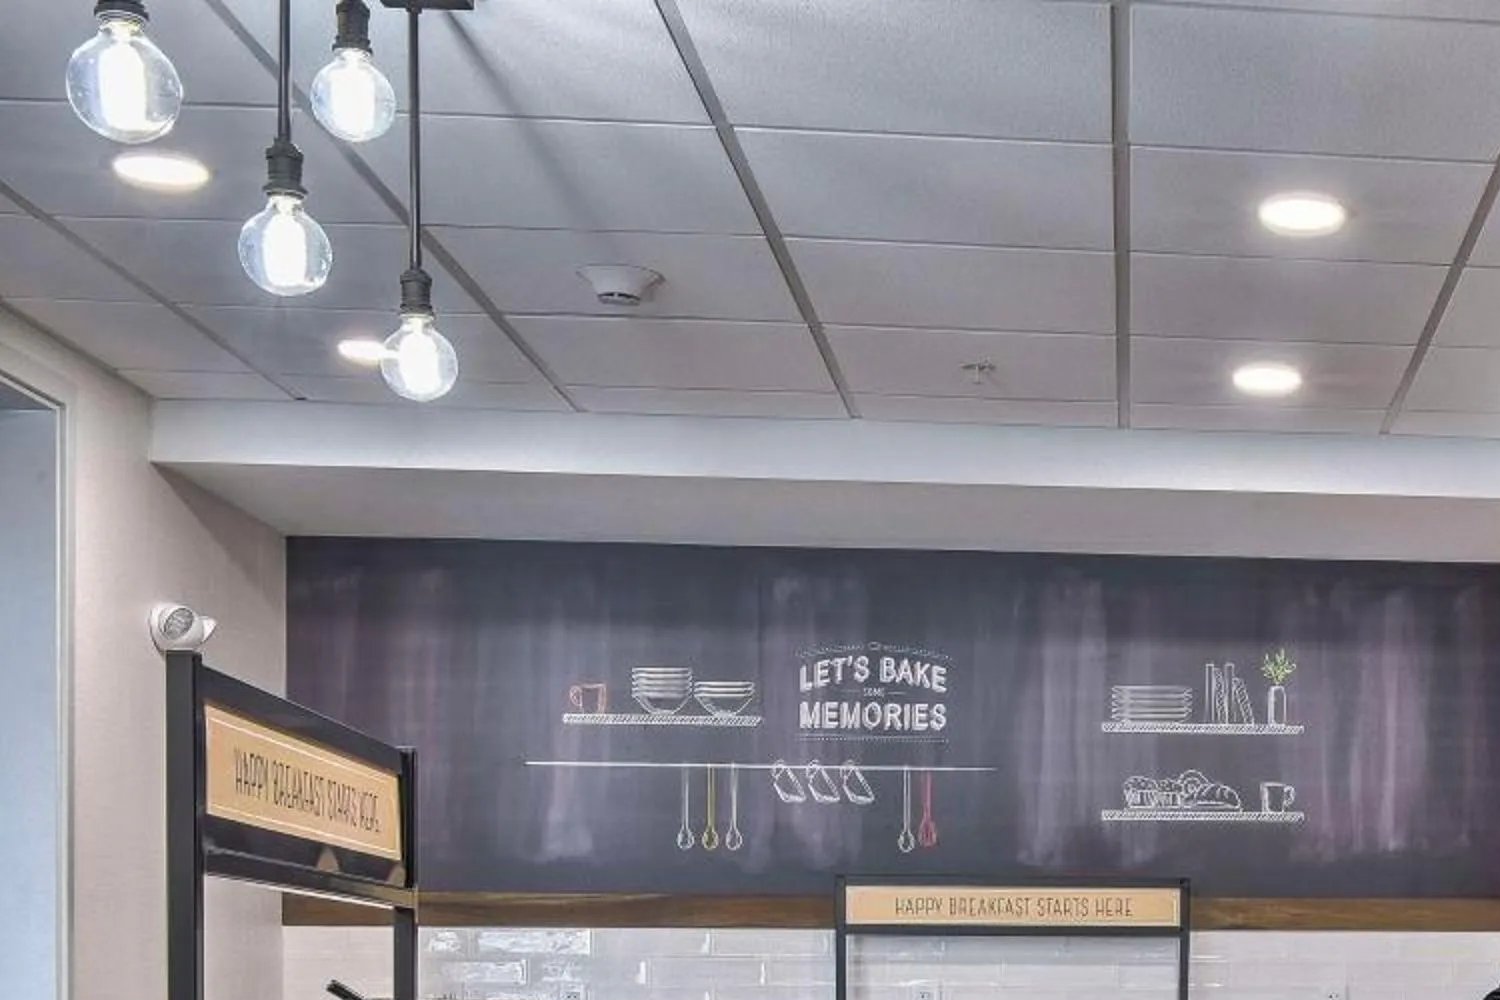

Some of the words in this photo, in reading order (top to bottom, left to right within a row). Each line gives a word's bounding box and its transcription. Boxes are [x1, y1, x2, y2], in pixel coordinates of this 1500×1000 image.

[799, 655, 870, 692] LET'S
[879, 656, 948, 694] BAKE
[799, 701, 948, 731] MEMORIES
[234, 746, 269, 801] HAPPY
[272, 760, 325, 817] BREAKFAST
[327, 779, 357, 828] STARTS
[359, 790, 381, 833] HERE
[895, 897, 943, 915] HAPPY
[949, 897, 1030, 916] BREAKFAST
[1036, 898, 1088, 917] STARTS
[1095, 899, 1132, 917] HERE
